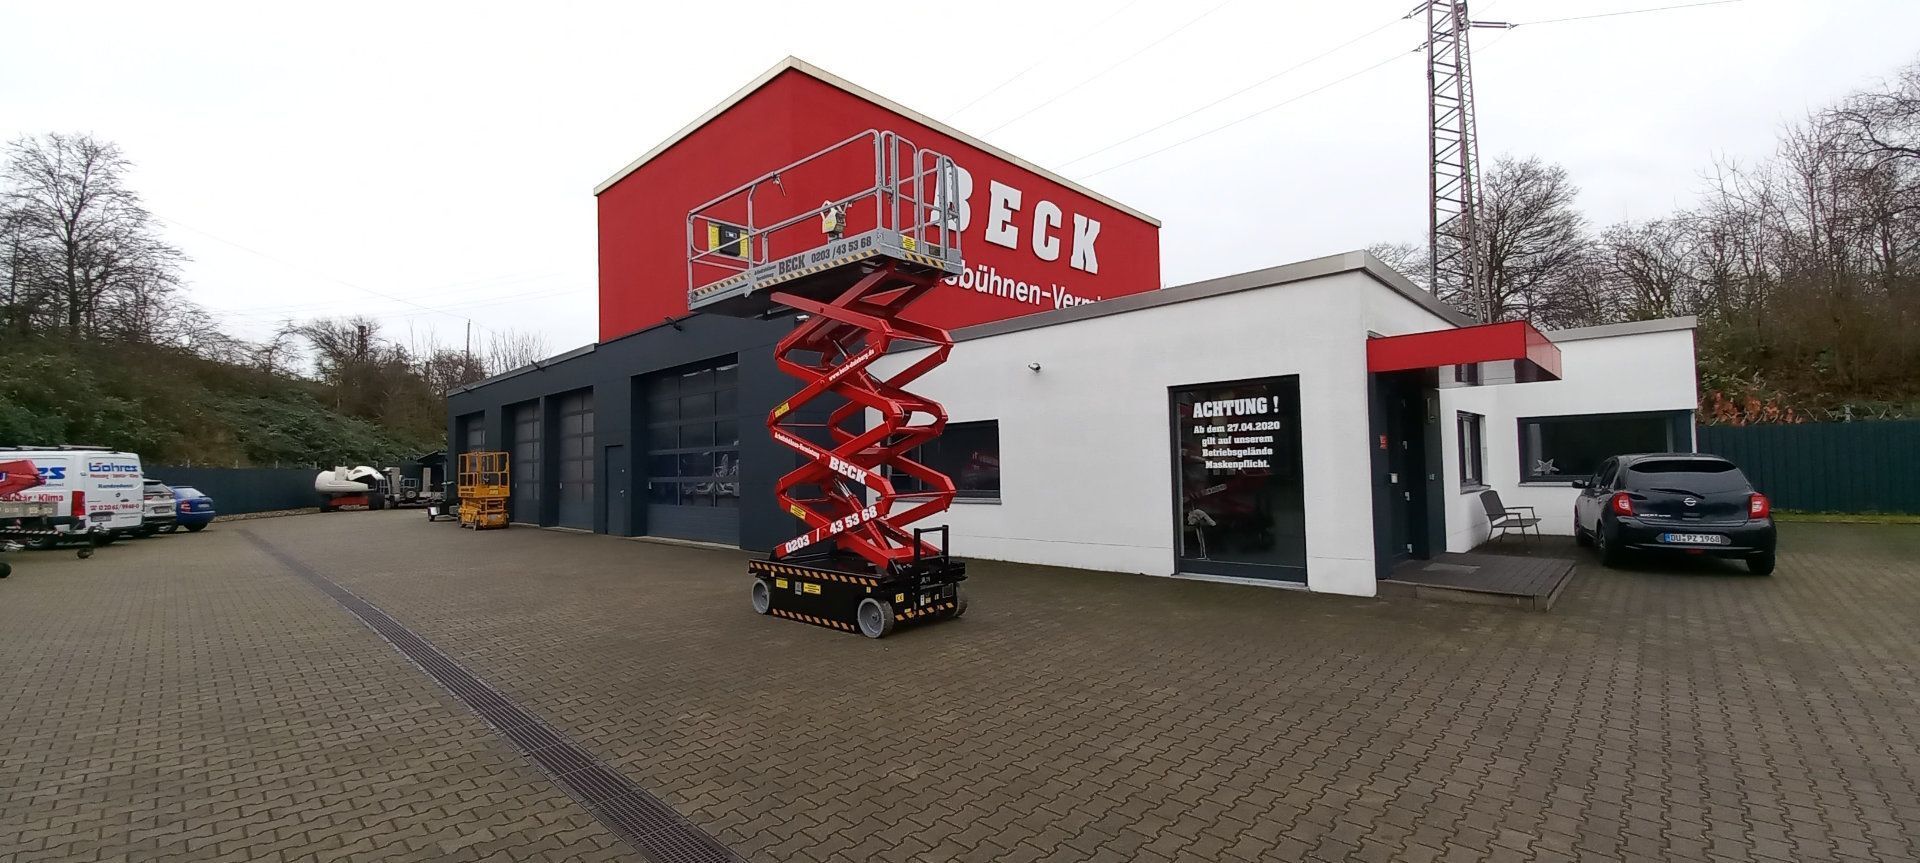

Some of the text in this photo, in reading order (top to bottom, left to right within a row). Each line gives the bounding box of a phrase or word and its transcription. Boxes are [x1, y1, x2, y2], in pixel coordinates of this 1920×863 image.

[930, 164, 1101, 275] BECK
[778, 255, 806, 276] BECK
[811, 249, 830, 263] 0203
[848, 240, 859, 252] 53
[861, 236, 872, 248] 68
[1192, 396, 1280, 418] ACHTUNG !
[1194, 421, 1281, 434] Ab dem 27.04.2020
[1202, 436, 1274, 447] gilt auf unserem
[1202, 447, 1273, 458] Betriebsgelände
[829, 455, 868, 485] BECK
[1205, 460, 1270, 470] Maskenpflicht.
[38, 493, 64, 502] Klima
[785, 534, 810, 553] 0203
[830, 519, 844, 534] 43
[845, 513, 860, 528] 53
[862, 505, 877, 521] 68
